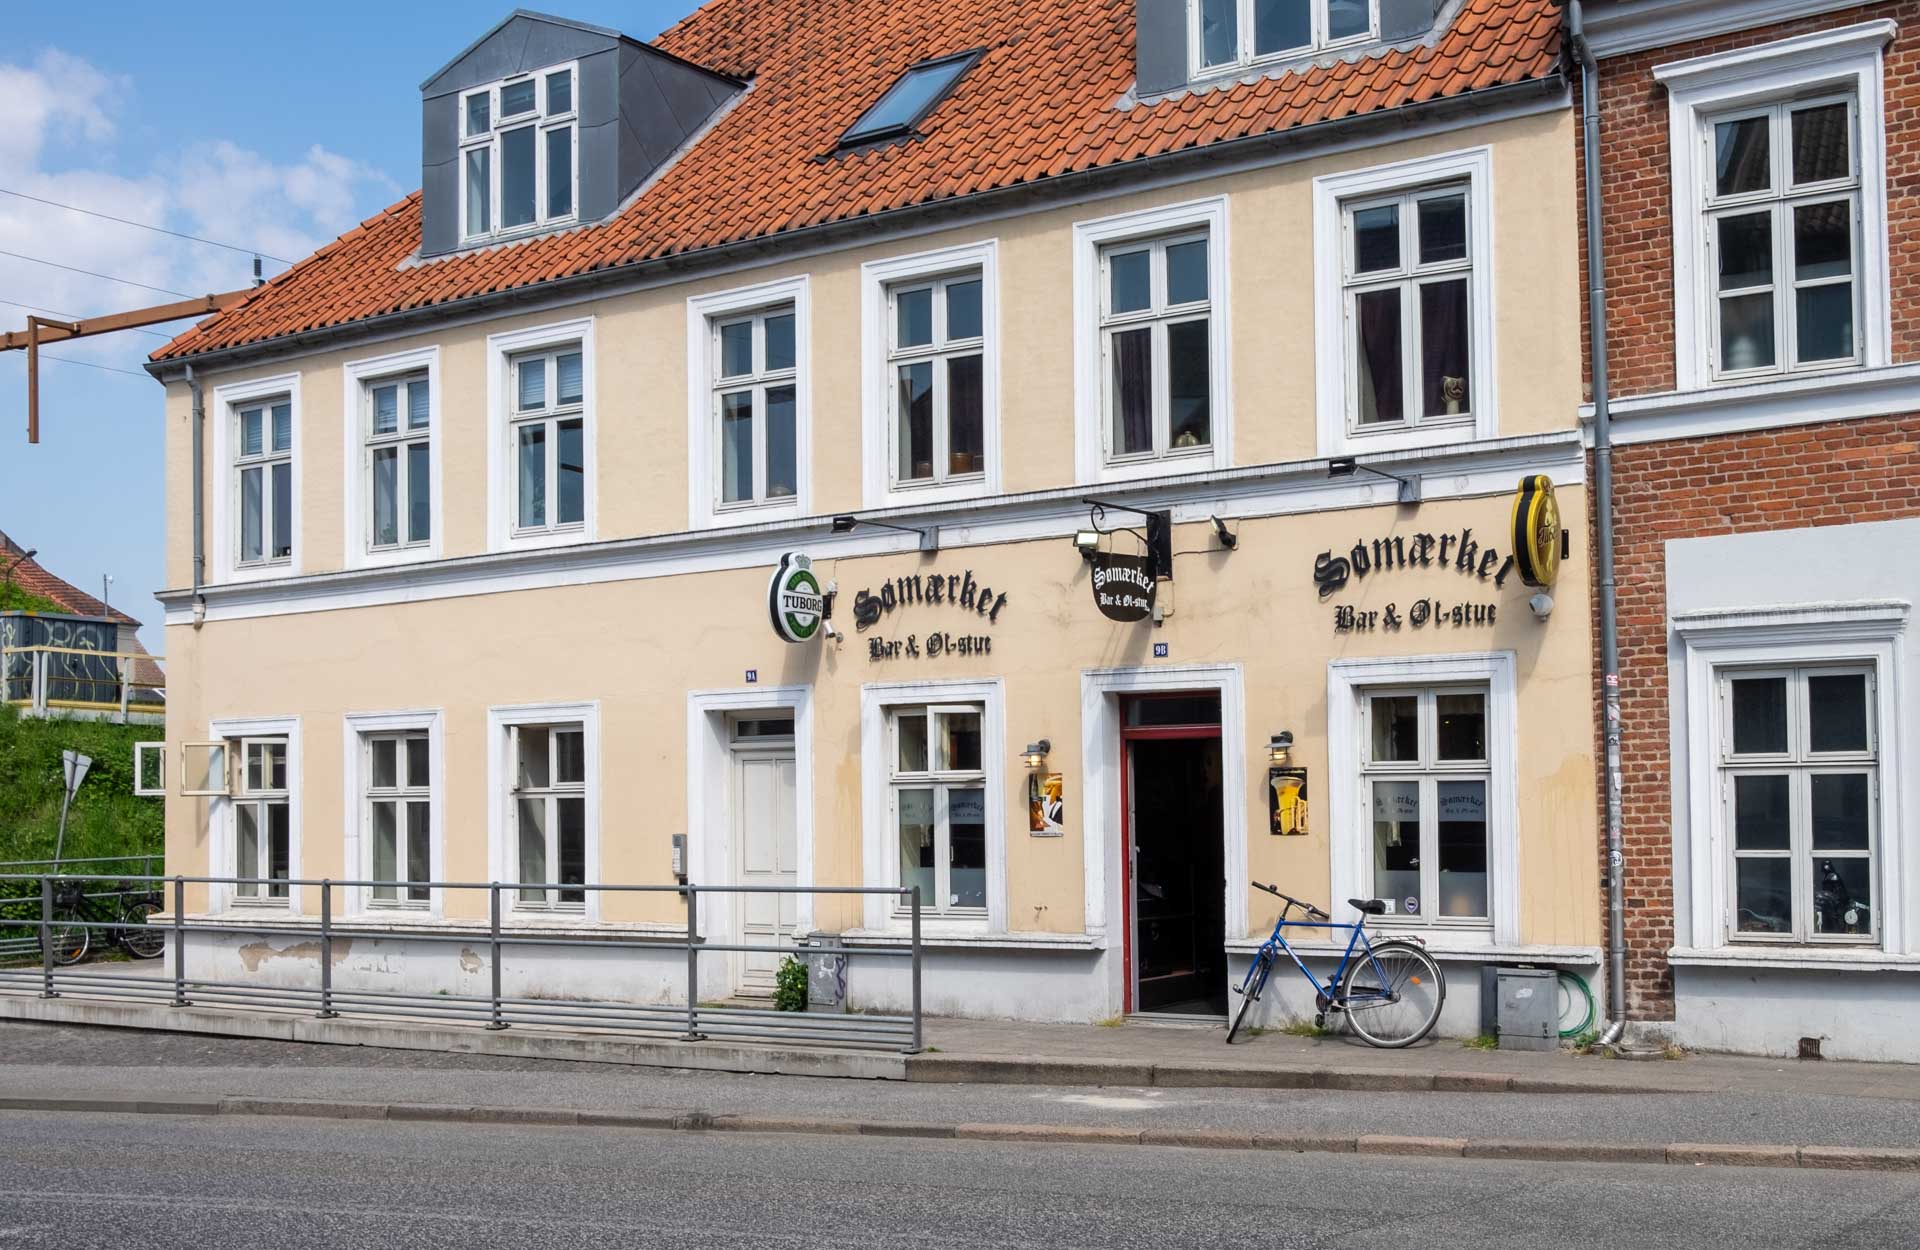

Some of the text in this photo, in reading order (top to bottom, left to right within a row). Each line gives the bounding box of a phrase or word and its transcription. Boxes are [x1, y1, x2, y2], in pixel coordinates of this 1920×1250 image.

[783, 594, 822, 612] TUBORG
[1100, 592, 1113, 607] Bar
[1115, 594, 1121, 606] &
[1335, 597, 1497, 633] Bar & Øl-stue
[868, 631, 992, 662] Bar & Øl-stue
[1155, 645, 1166, 655] 9B
[747, 671, 756, 681] 9A
